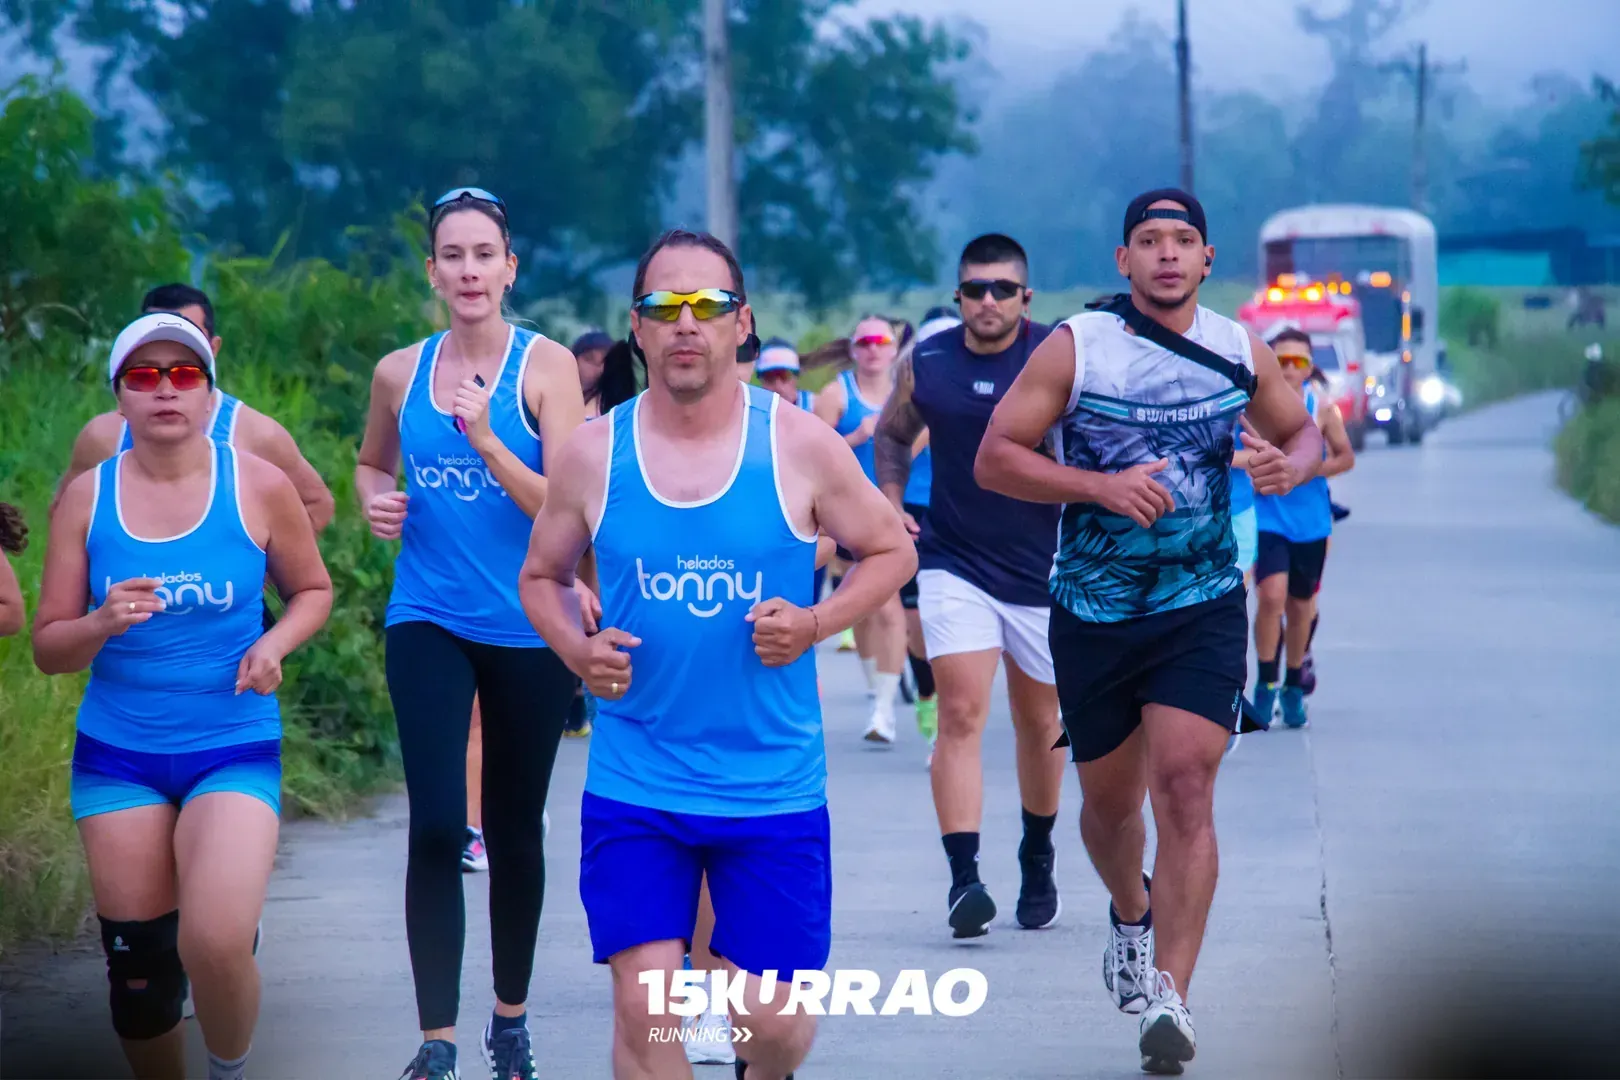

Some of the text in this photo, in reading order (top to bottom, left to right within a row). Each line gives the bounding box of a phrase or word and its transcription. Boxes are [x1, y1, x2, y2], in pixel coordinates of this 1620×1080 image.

[1136, 402, 1213, 423] SWIMSUIT
[438, 453, 482, 466] helados
[677, 554, 735, 570] helados
[143, 570, 202, 584] elados
[636, 557, 763, 614] tonny
[105, 576, 234, 613] nny
